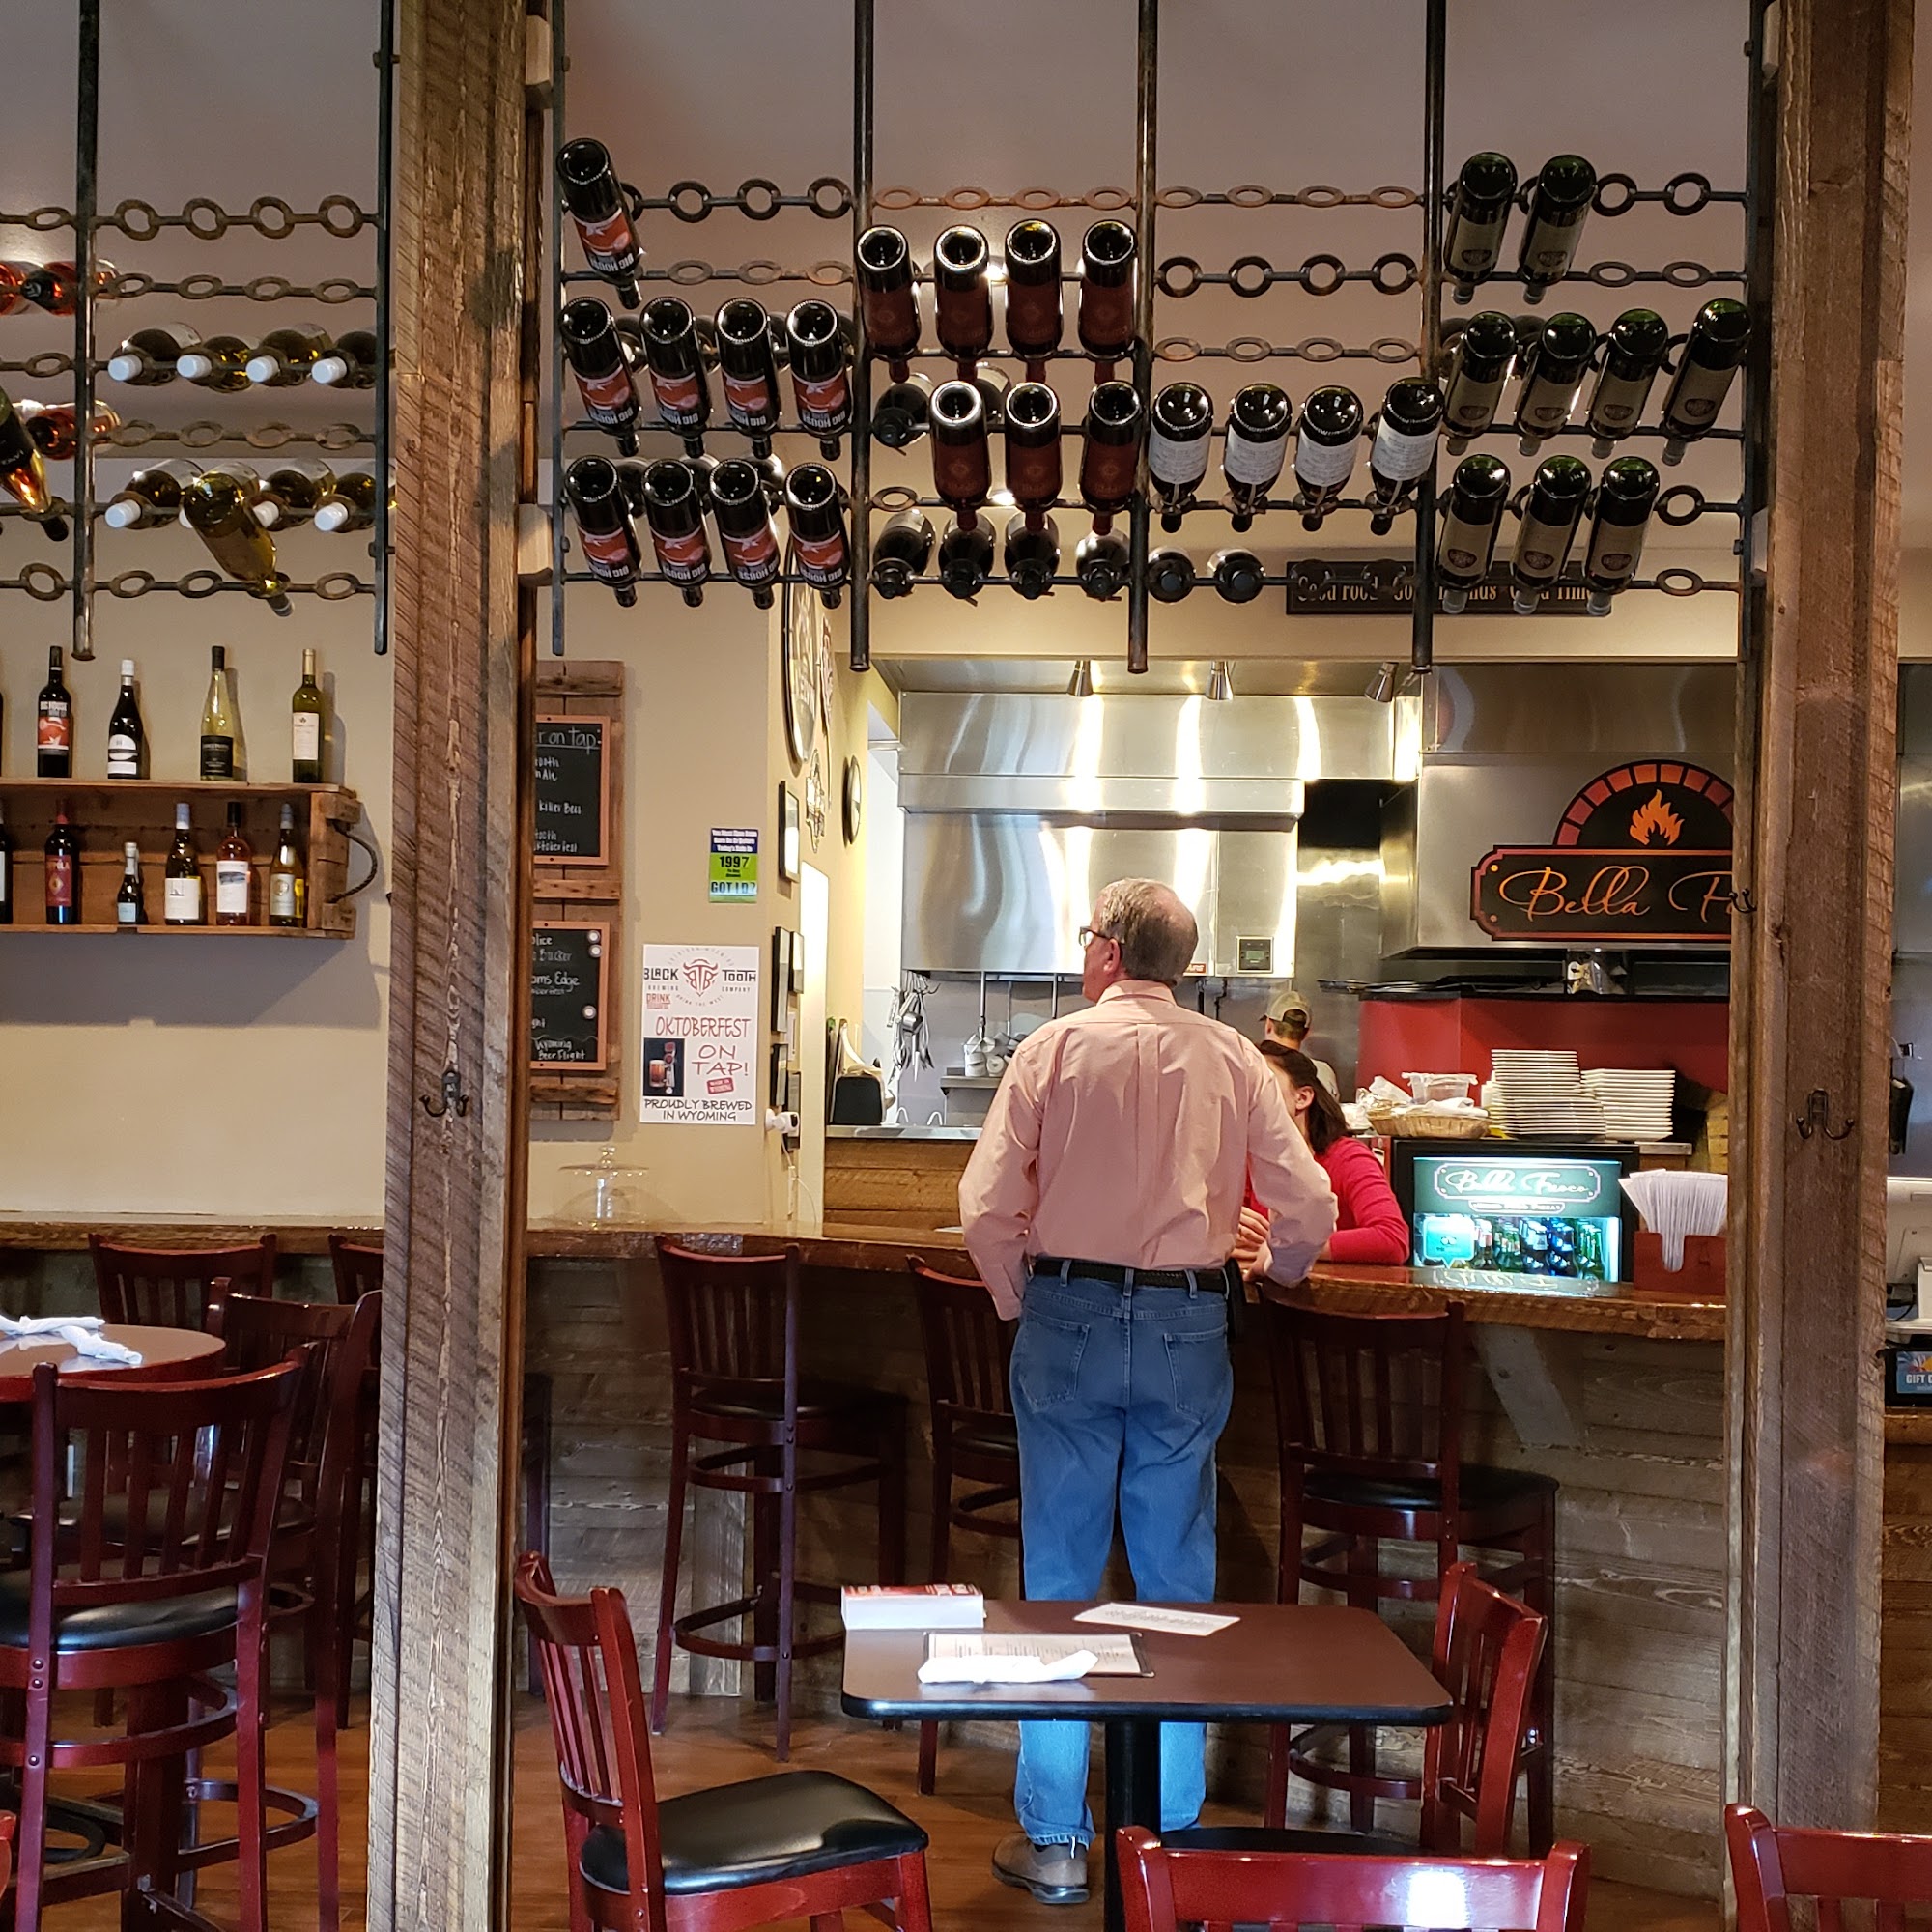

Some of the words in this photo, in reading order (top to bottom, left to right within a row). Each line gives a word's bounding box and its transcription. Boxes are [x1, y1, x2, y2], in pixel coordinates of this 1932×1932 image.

[549, 731, 566, 745] on
[719, 855, 750, 868] 1997
[711, 881, 732, 894] GOT
[1499, 866, 1651, 922] Bella
[643, 967, 679, 980] BLACK
[722, 969, 756, 982] TOOTH
[656, 1016, 752, 1037] OKTOBERFEST
[698, 1044, 736, 1060] ON
[692, 1061, 749, 1077] TAP!
[644, 1098, 699, 1110] PROUDLY
[702, 1099, 753, 1111] BREWED
[663, 1110, 675, 1120] IN
[678, 1110, 736, 1121] WYOMING
[1906, 1374, 1925, 1384] GIFT
